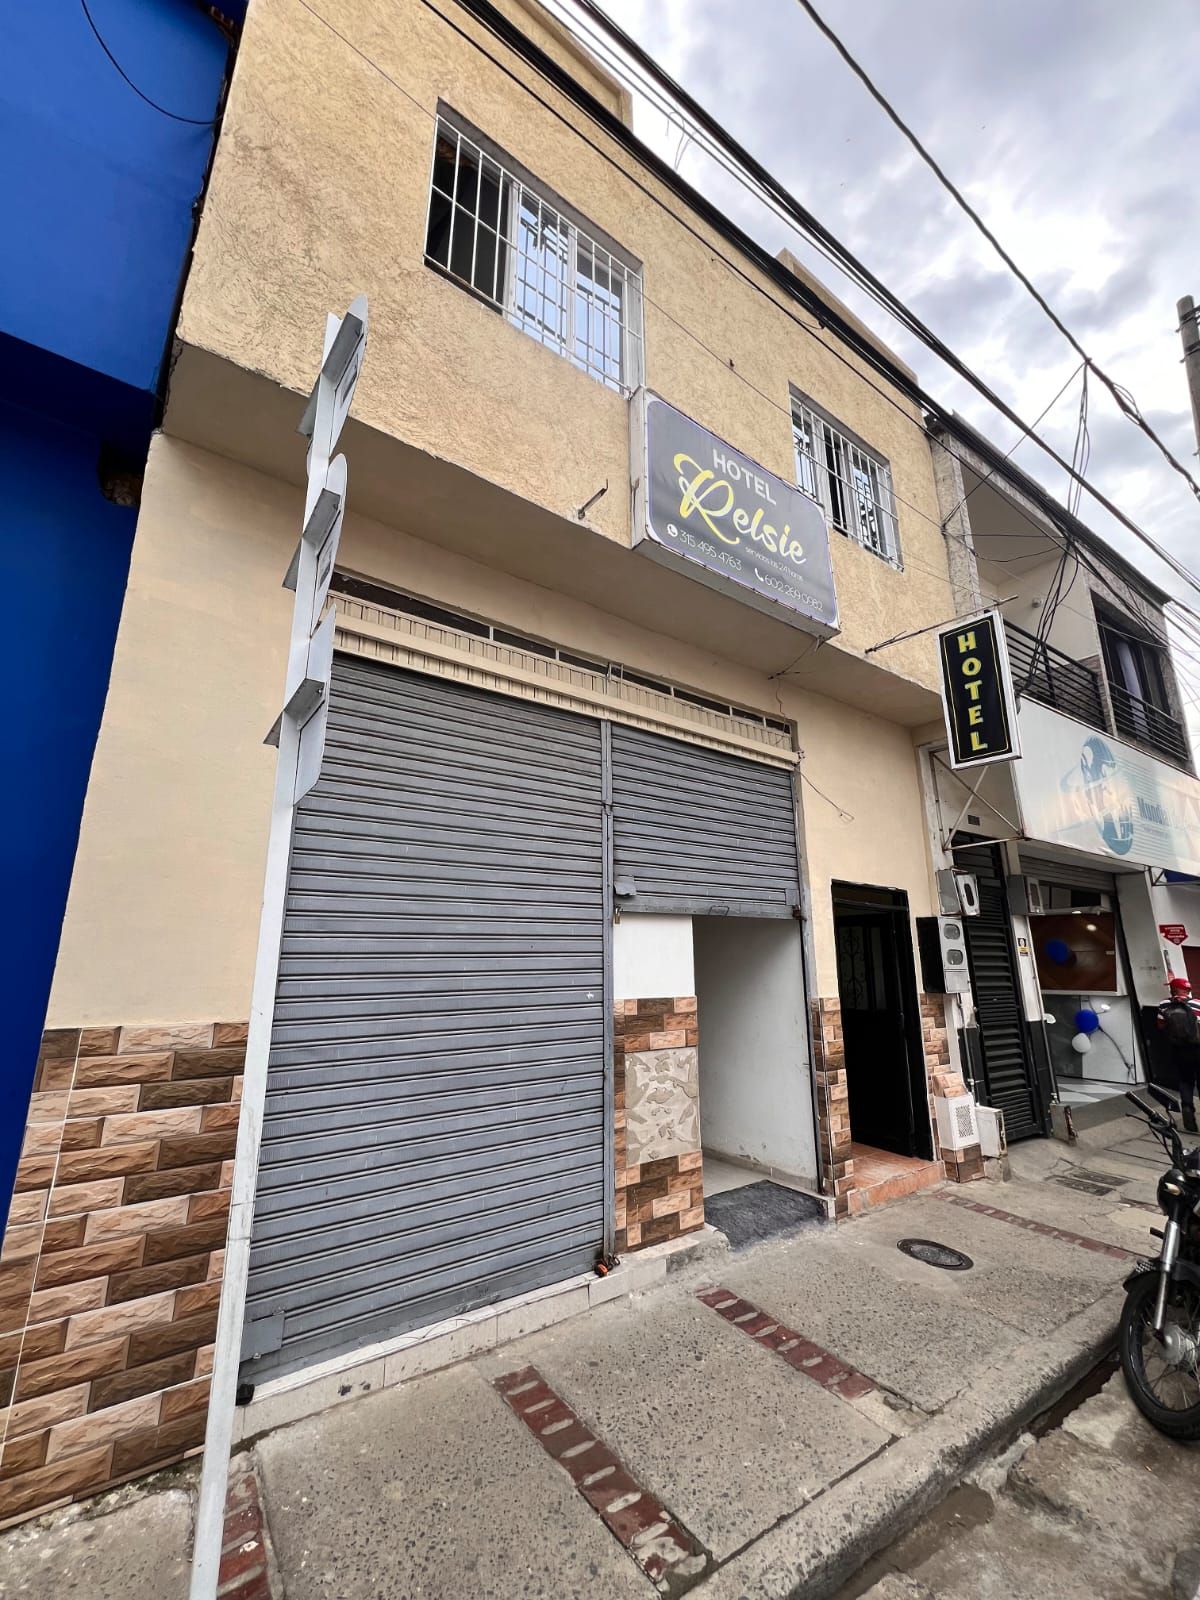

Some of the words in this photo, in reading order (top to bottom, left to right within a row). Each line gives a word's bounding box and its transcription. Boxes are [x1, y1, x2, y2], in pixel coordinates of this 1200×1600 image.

[712, 448, 777, 506] HOTEL
[673, 453, 807, 564] Relsie
[680, 529, 696, 547] 315
[697, 541, 717, 558] 495
[718, 552, 742, 571] 4763
[765, 574, 784, 592] 602
[957, 631, 988, 752] HOTEL
